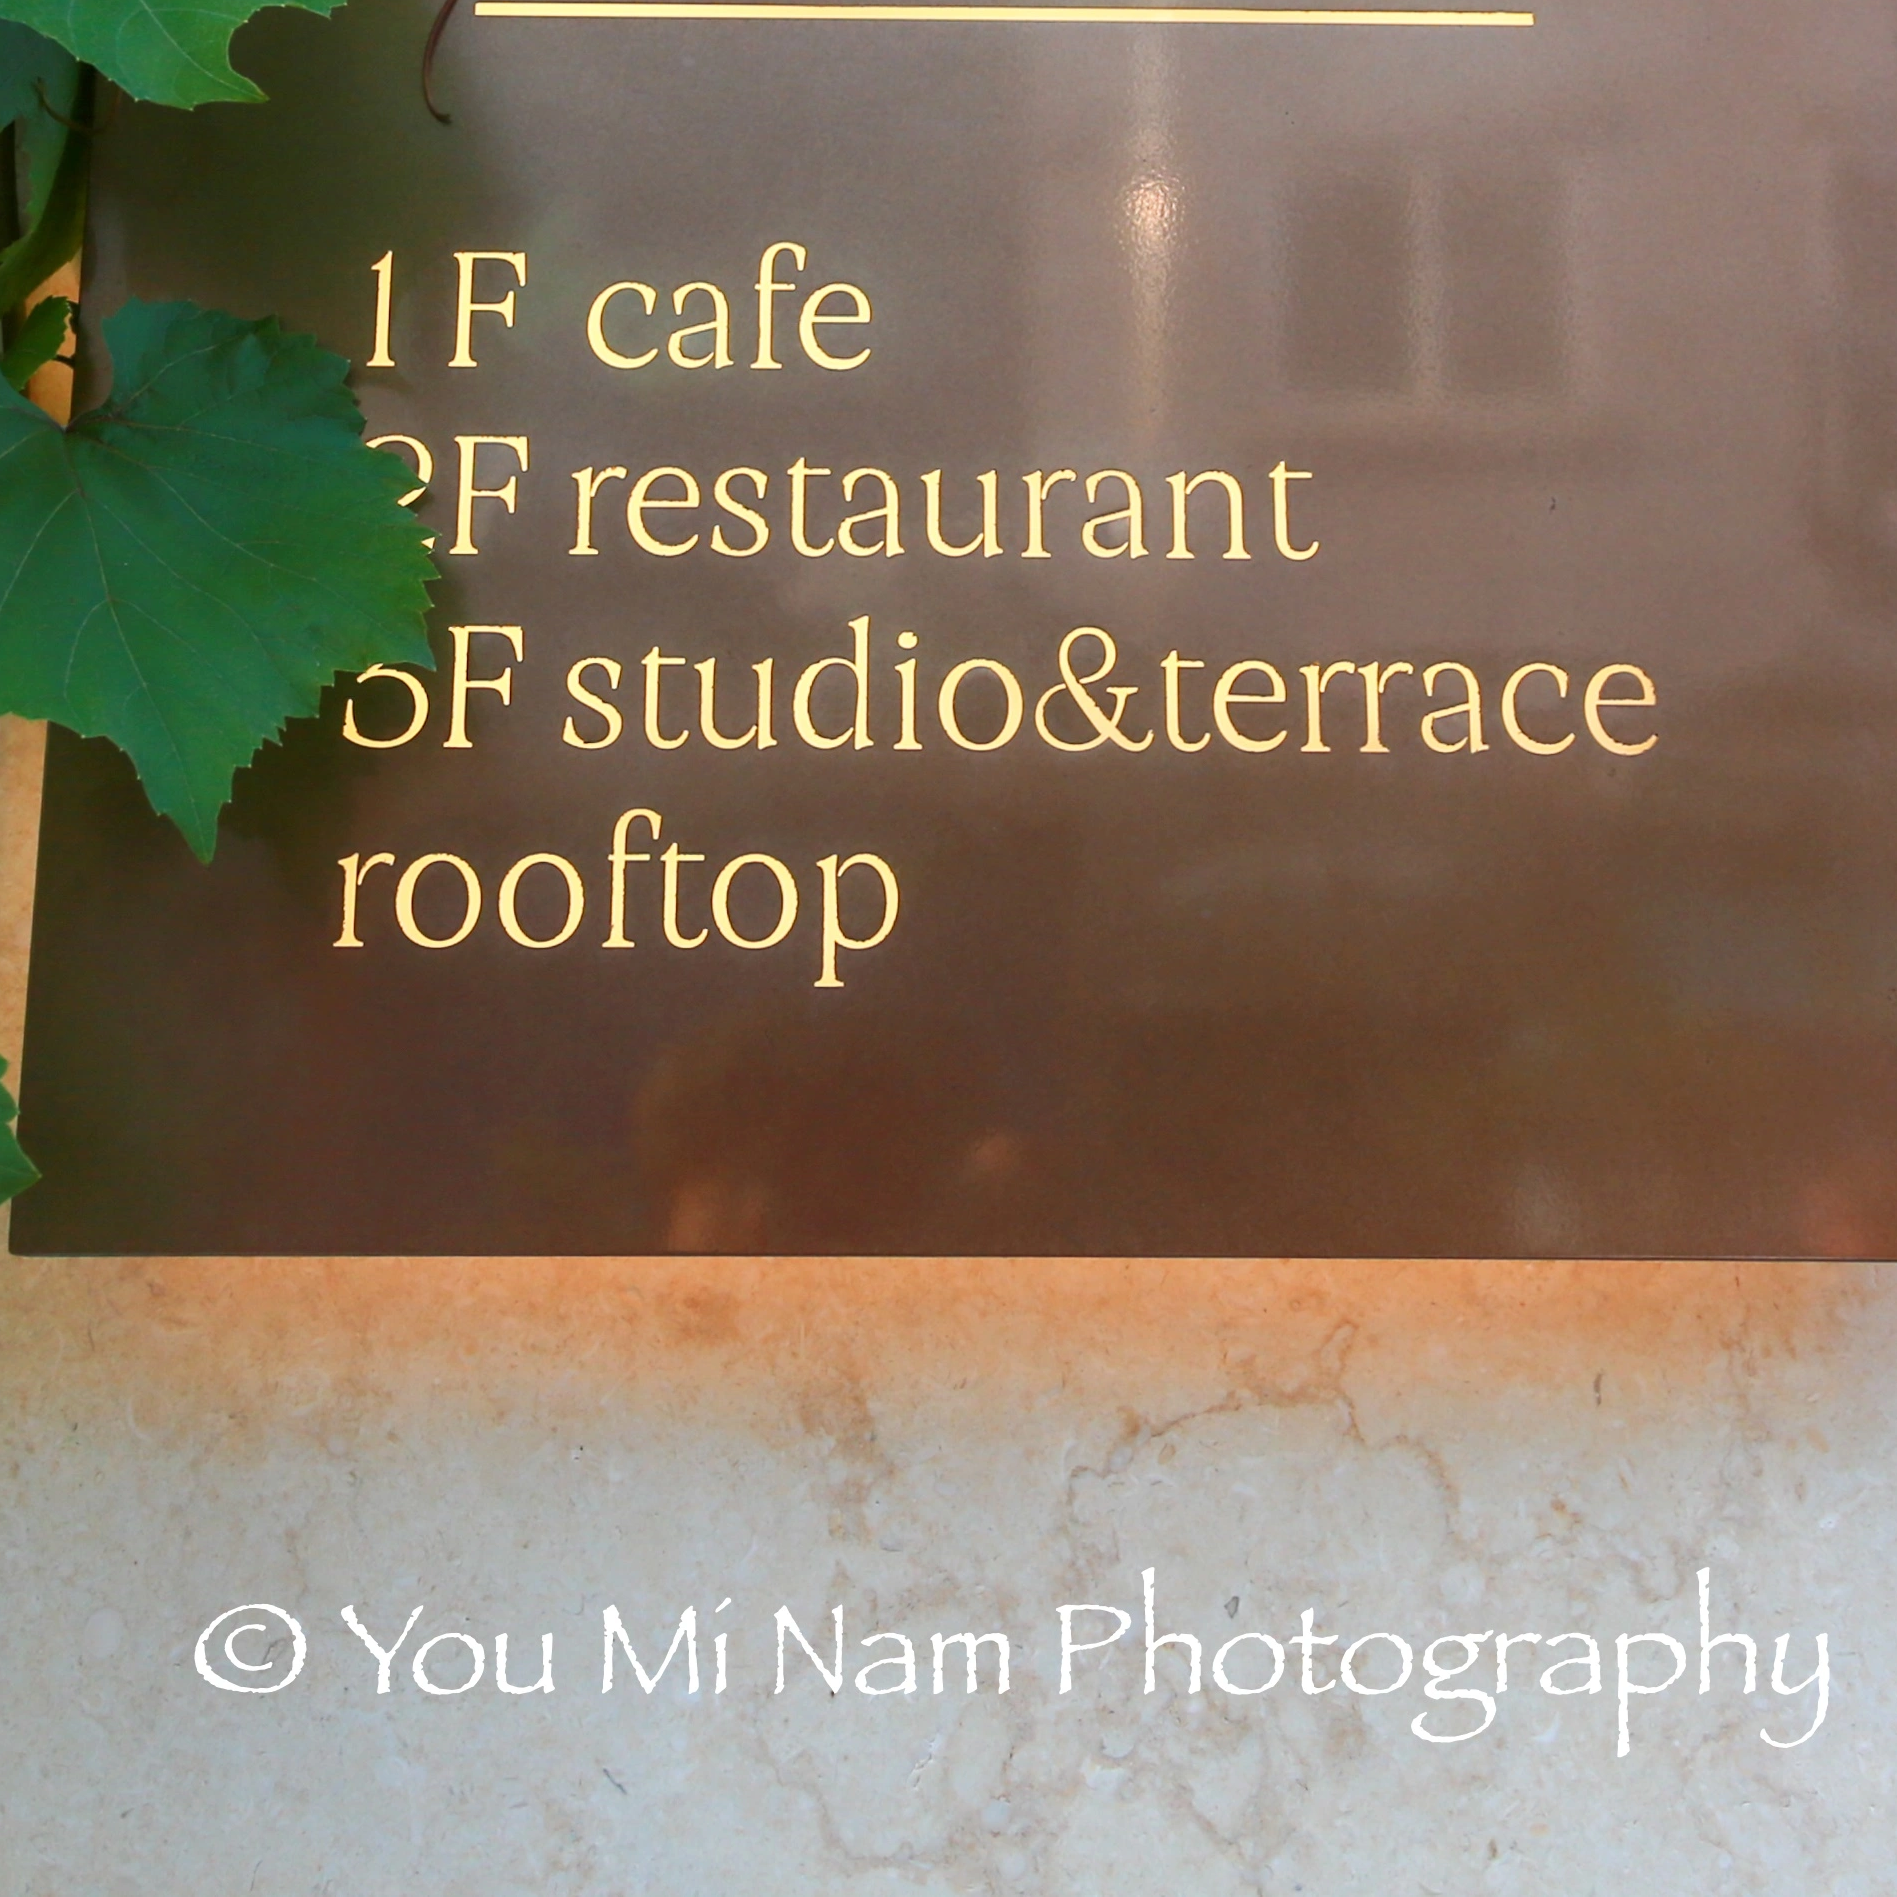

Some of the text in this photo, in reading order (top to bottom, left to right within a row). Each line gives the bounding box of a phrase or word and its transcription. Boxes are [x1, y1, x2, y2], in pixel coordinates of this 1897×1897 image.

[585, 241, 873, 371] cafe
[567, 456, 1320, 562] restaurant
[561, 614, 1659, 757] studio&terrace
[332, 807, 900, 989] rooftop
